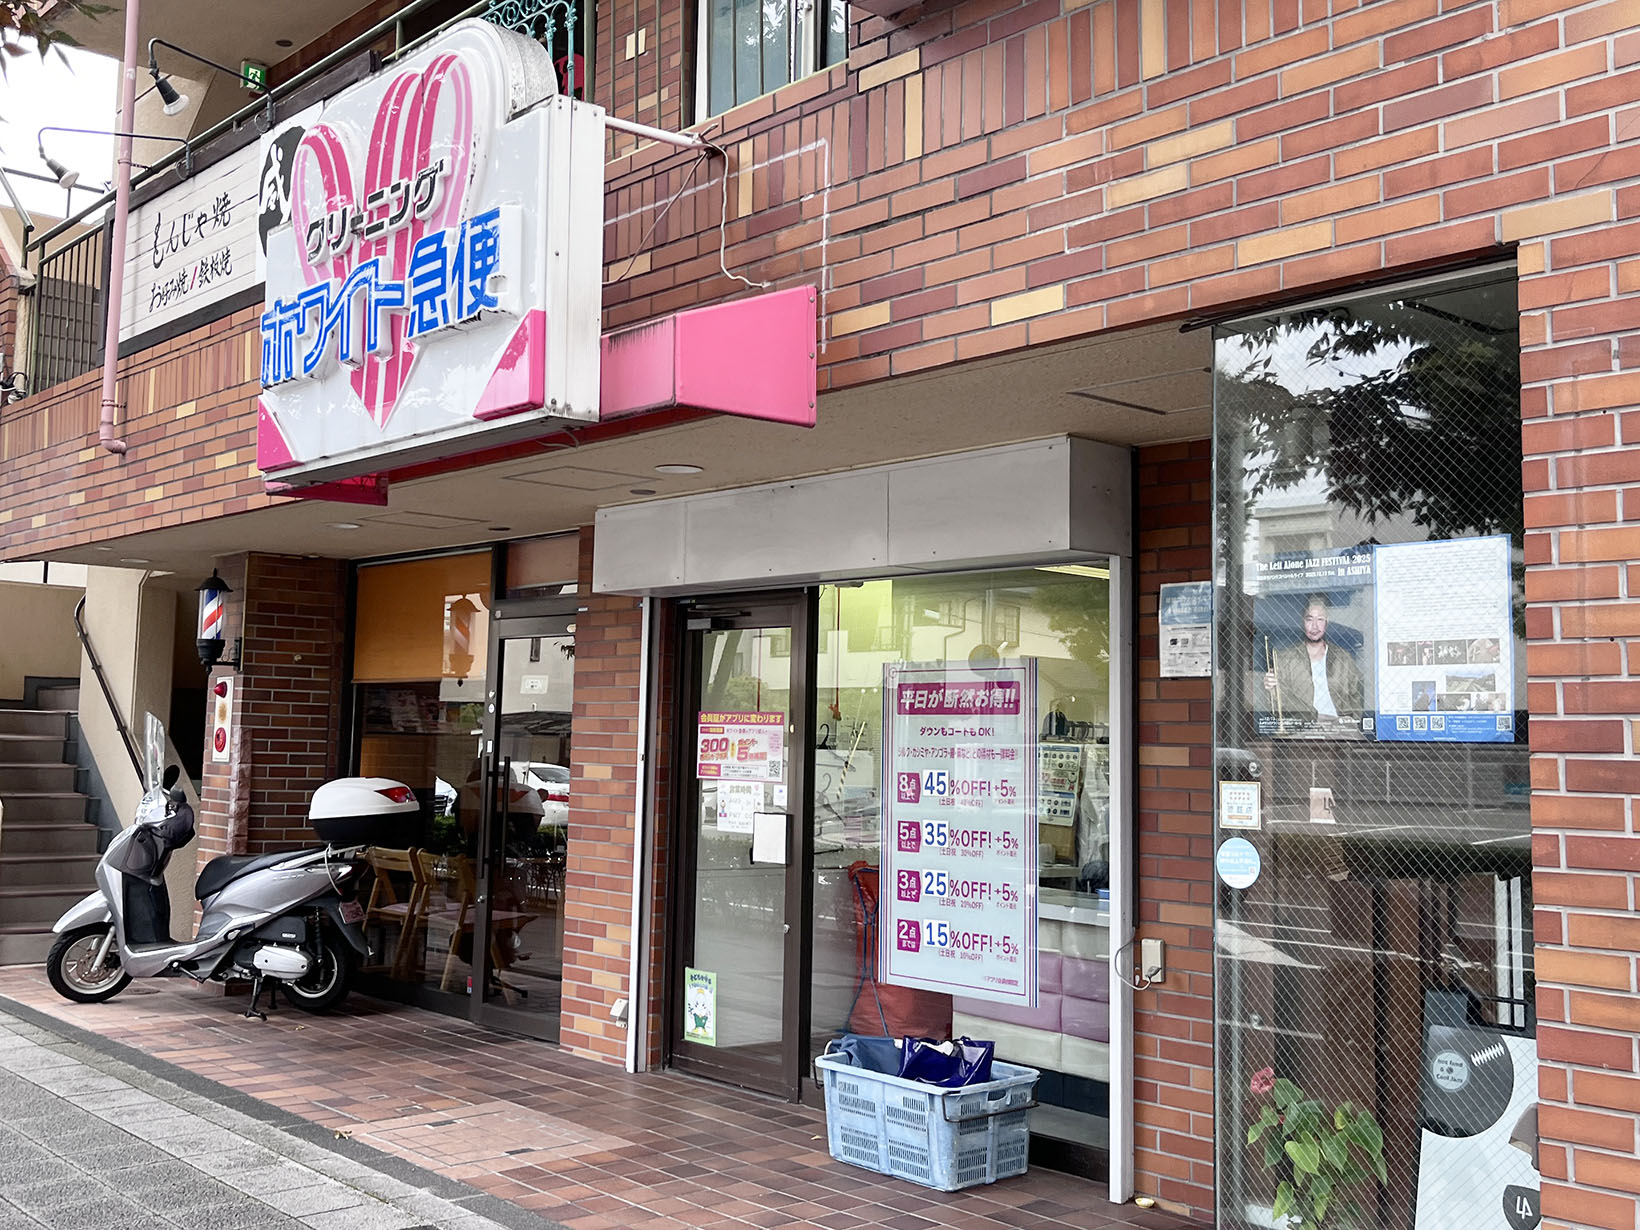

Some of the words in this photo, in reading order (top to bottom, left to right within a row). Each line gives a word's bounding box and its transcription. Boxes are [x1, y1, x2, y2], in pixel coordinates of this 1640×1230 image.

[306, 159, 443, 262] クリーニング
[153, 192, 231, 269] もんじゃ焼
[261, 207, 500, 388] ホワイト急便
[1256, 563, 1268, 572] The
[1284, 559, 1303, 570] Alone
[1306, 558, 1319, 569] JAZZ
[1322, 555, 1350, 566] FESTIVAL
[1352, 553, 1371, 564] 2025
[1347, 565, 1371, 576] ASHIYA
[901, 687, 1016, 710] 平日が断然お得!!
[701, 713, 782, 723] 会員証がアプリに変わります
[701, 738, 729, 754] 300
